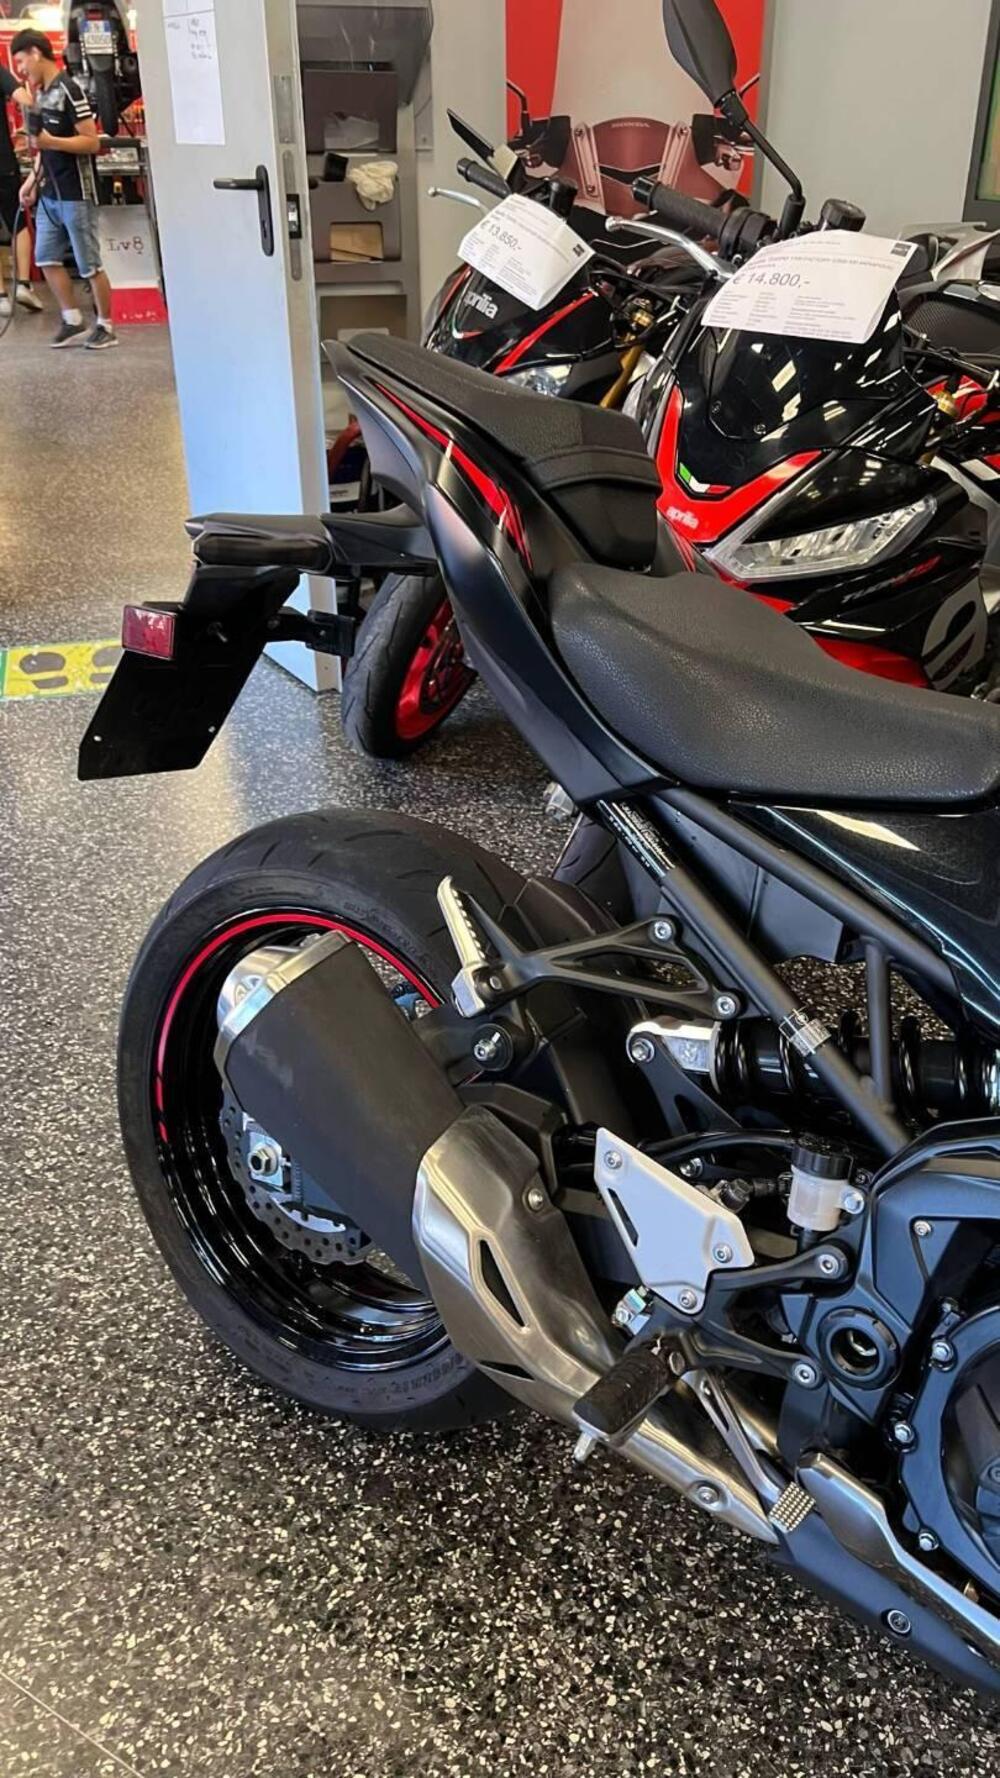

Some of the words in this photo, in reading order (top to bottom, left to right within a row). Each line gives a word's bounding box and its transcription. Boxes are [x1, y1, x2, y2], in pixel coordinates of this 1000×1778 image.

[480, 220, 491, 230] €
[733, 273, 745, 285] €
[748, 272, 811, 288] 14.800,-
[666, 506, 700, 529] aprilia
